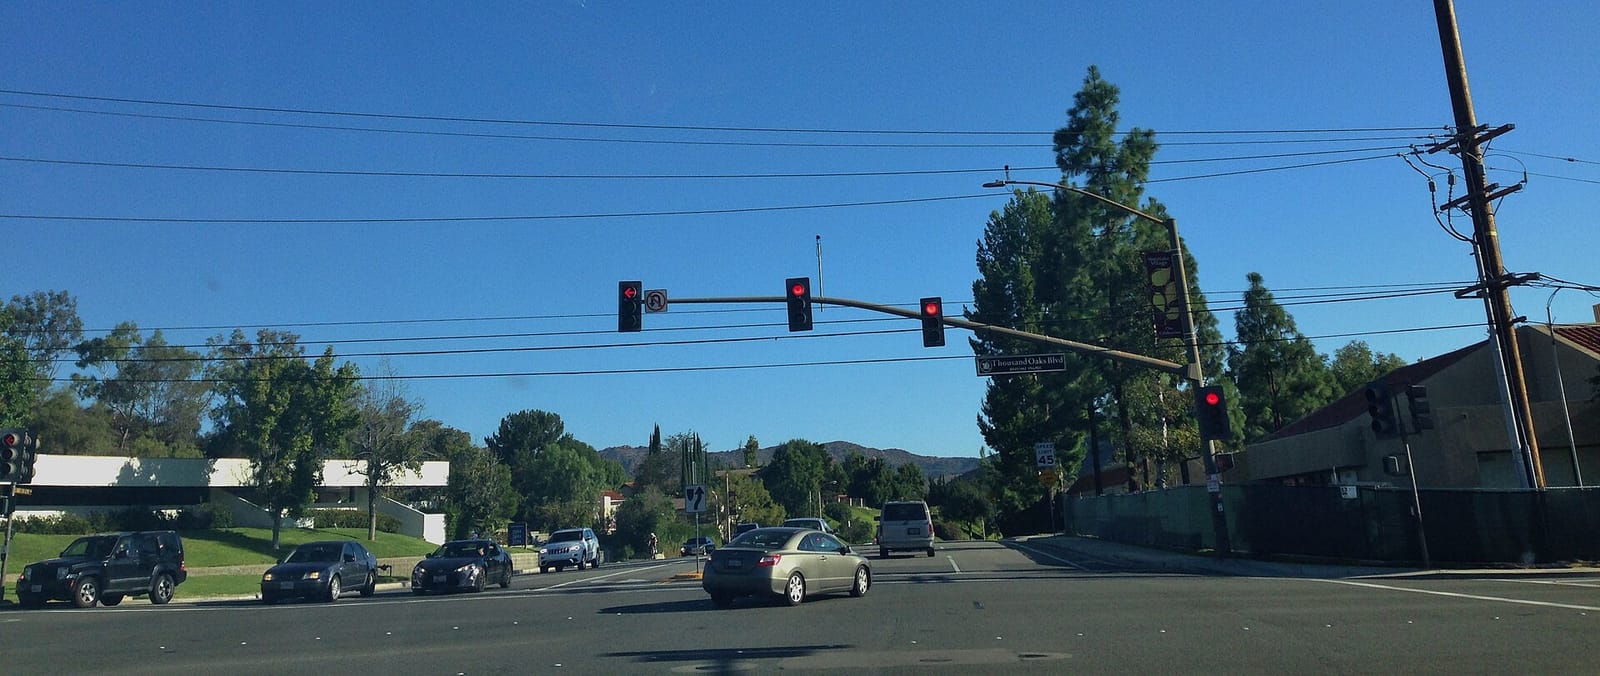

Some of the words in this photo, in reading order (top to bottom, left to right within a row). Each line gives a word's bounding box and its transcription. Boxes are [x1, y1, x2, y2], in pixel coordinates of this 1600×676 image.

[992, 357, 1027, 367] Thousand
[1028, 357, 1046, 365] Oaks
[1047, 356, 1063, 364] Blvd
[1038, 455, 1054, 465] 45
